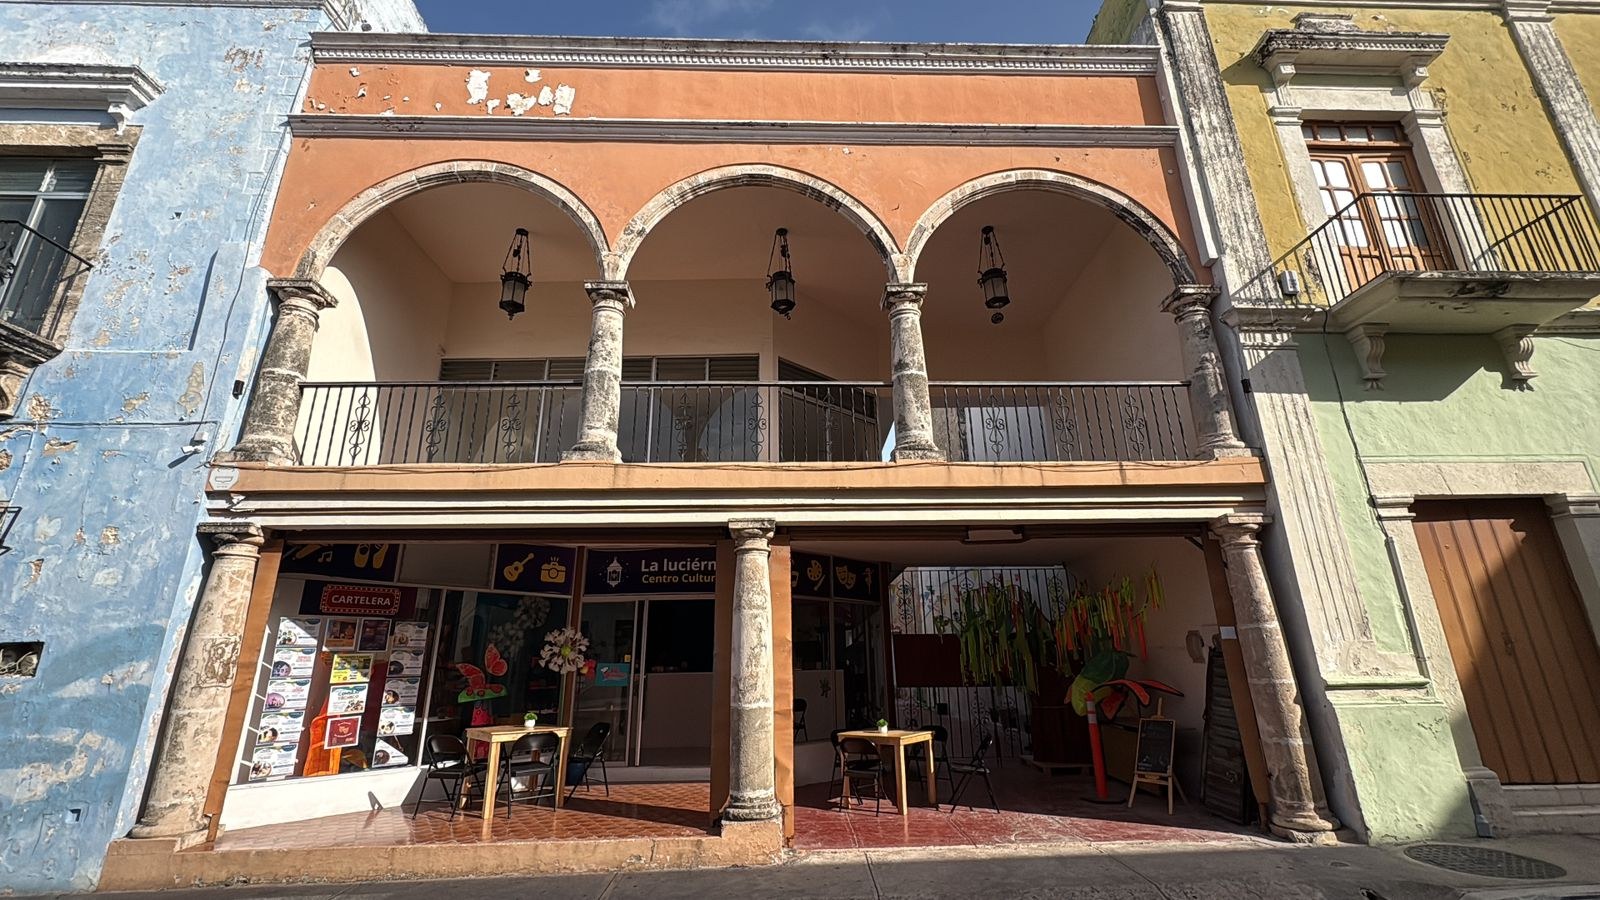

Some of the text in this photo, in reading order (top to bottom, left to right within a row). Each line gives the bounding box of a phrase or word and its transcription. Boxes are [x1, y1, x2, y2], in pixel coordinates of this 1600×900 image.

[641, 557, 716, 572] La luciérn
[641, 574, 679, 584] Centro
[331, 594, 391, 606] CARTELERA
